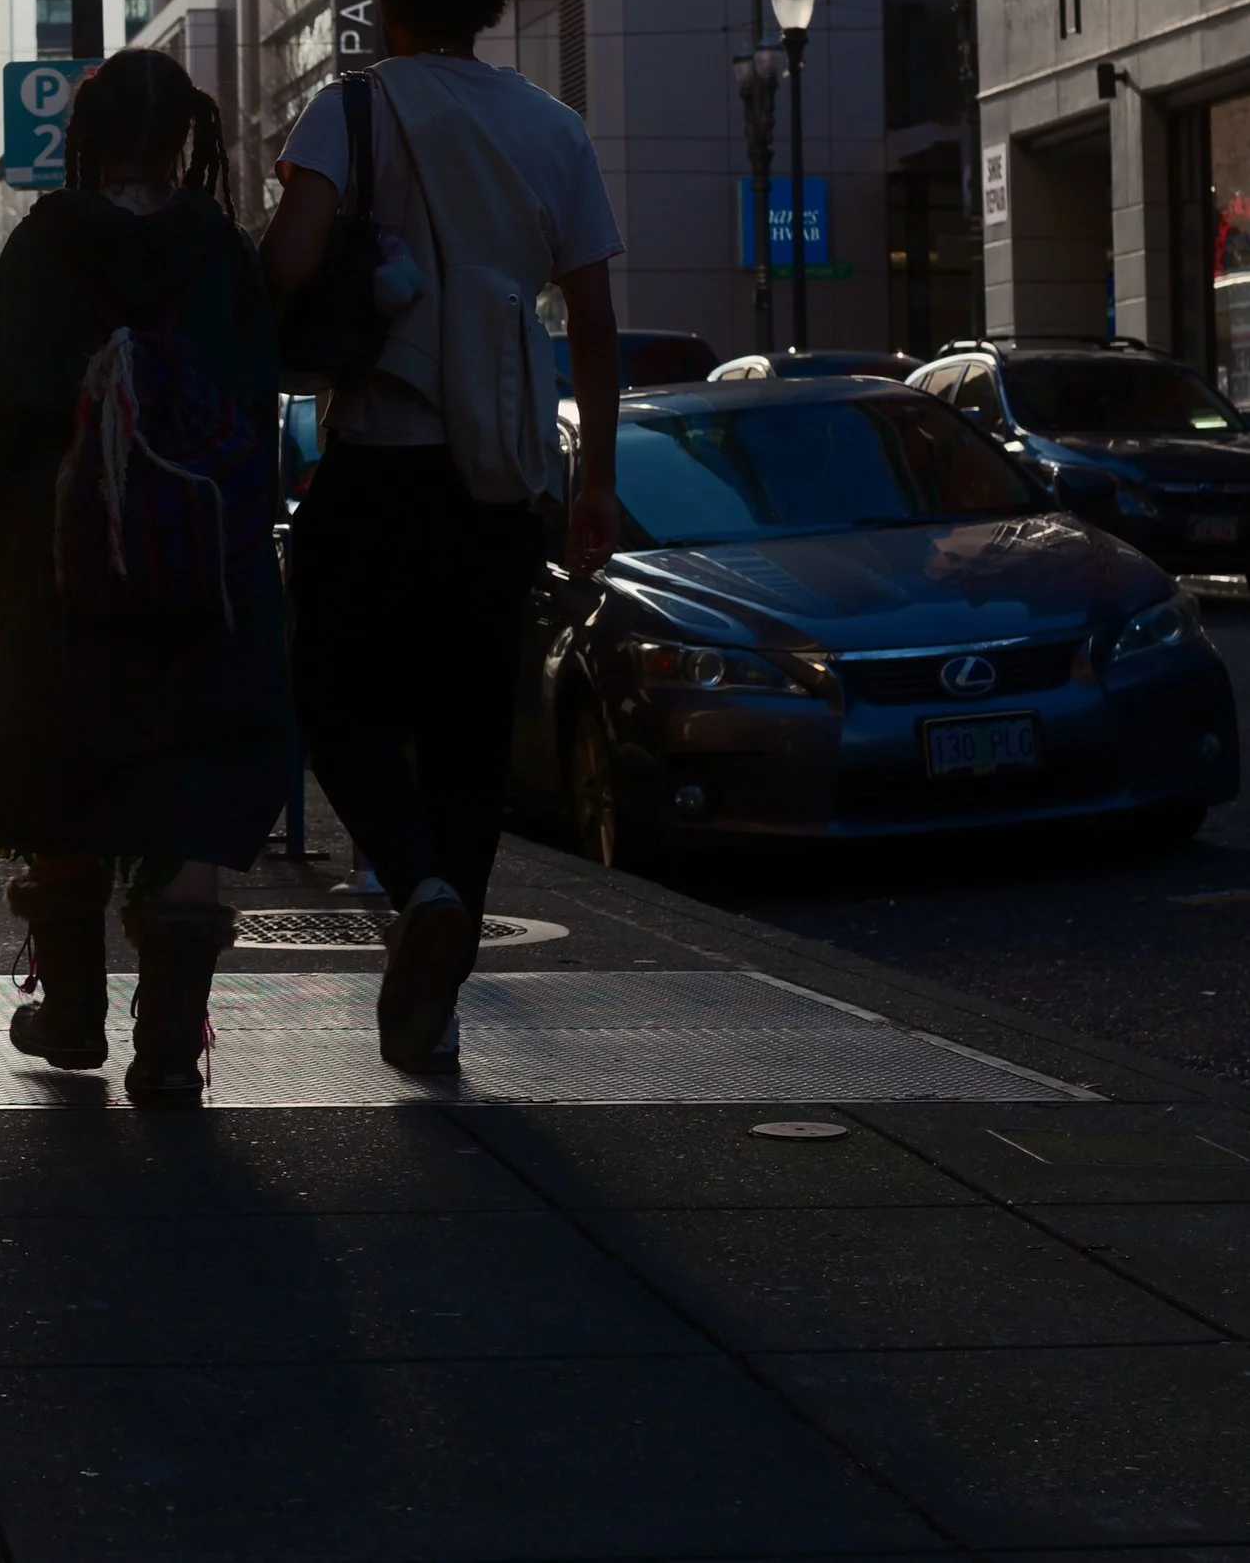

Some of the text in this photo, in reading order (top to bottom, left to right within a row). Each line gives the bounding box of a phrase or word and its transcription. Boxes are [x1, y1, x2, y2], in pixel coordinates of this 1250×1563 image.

[36, 75, 59, 109] P
[33, 123, 64, 167] 2
[989, 726, 1033, 760] PLG
